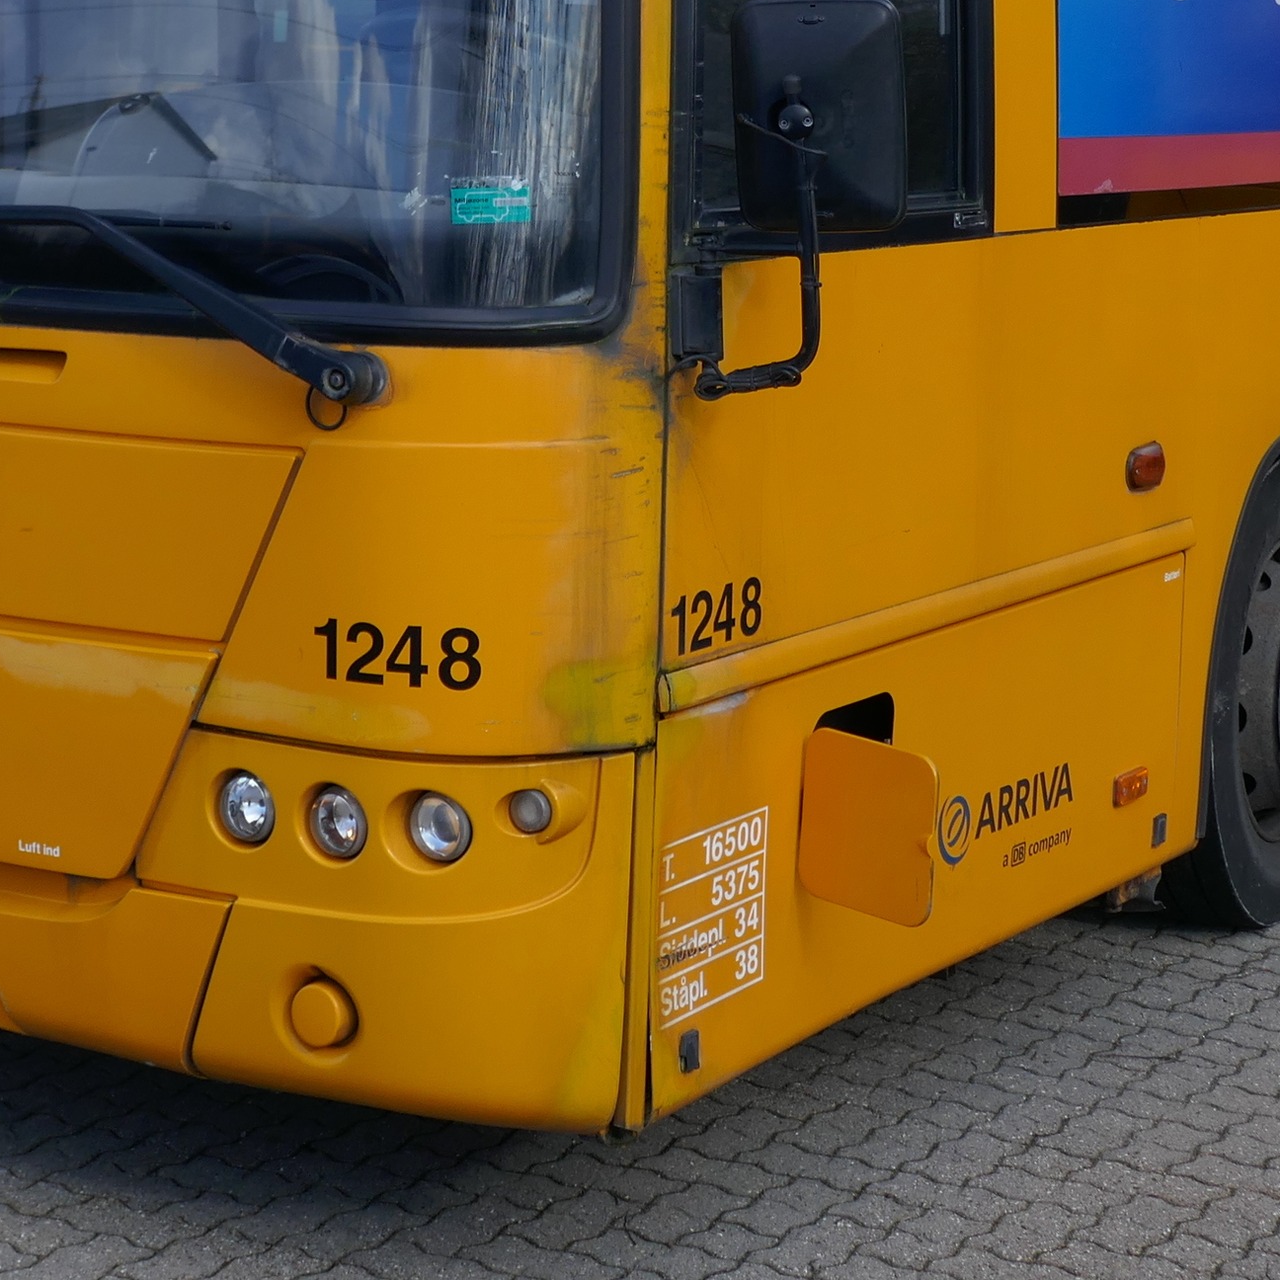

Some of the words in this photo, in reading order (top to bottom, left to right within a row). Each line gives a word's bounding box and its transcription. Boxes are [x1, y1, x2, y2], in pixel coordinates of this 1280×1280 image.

[670, 576, 762, 657] 1248
[313, 617, 483, 692] 1248
[974, 762, 1074, 840] ARRIVA
[18, 839, 41, 855] Luft
[42, 843, 62, 858] ind
[662, 852, 676, 882] T.
[702, 816, 763, 866] 16500
[1002, 853, 1009, 868] a
[1028, 827, 1072, 857] company
[659, 900, 677, 929] L.
[711, 859, 760, 906] 5375
[734, 901, 759, 938] 34
[660, 970, 708, 1017] Ståpl.
[735, 943, 759, 980] 38
